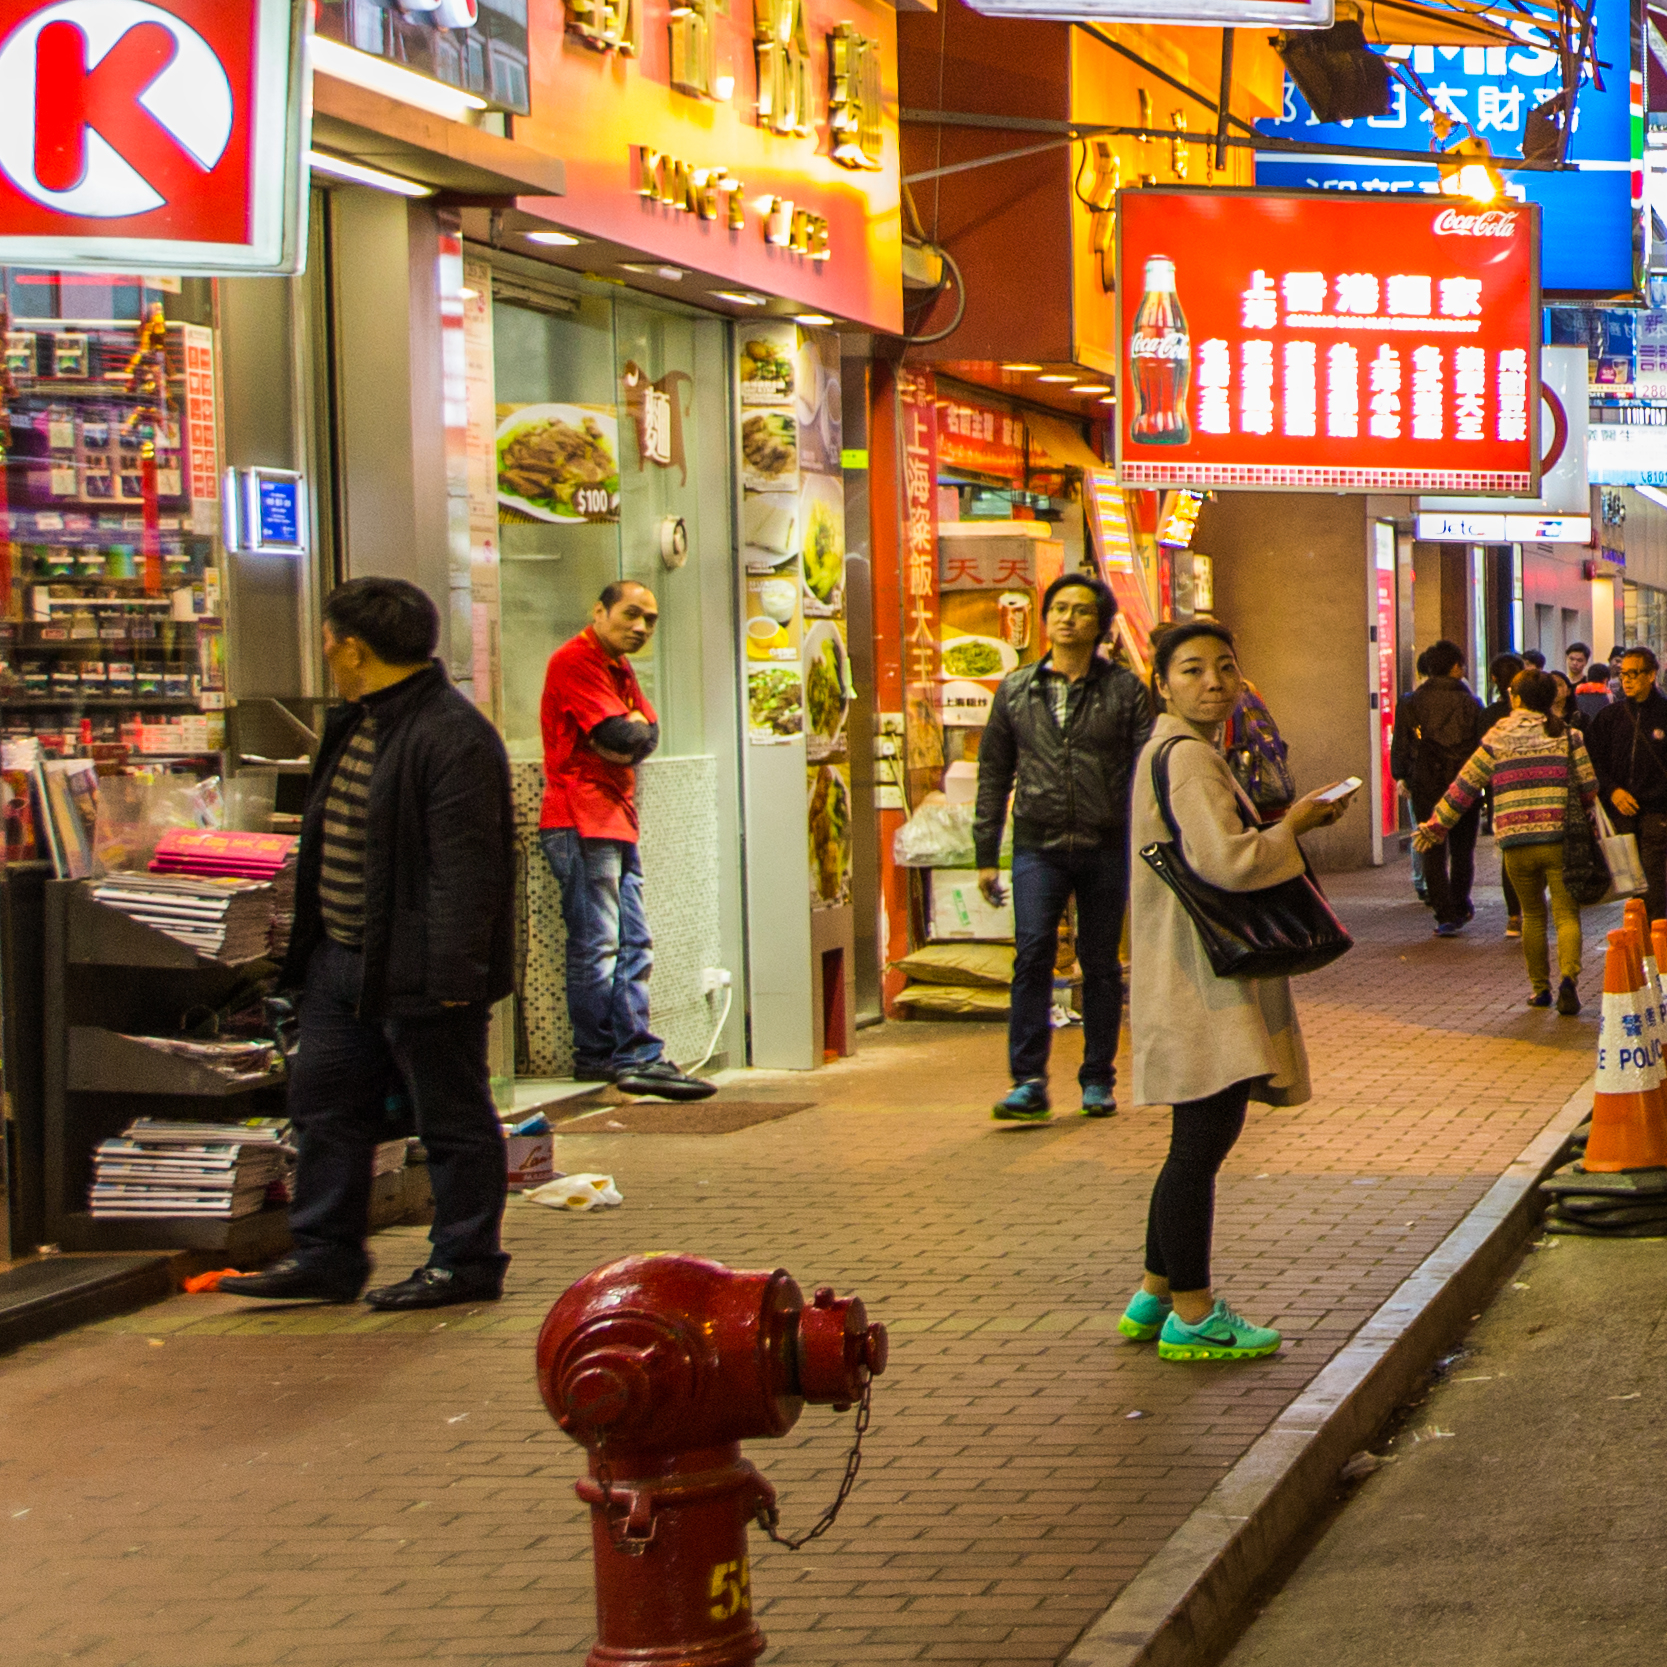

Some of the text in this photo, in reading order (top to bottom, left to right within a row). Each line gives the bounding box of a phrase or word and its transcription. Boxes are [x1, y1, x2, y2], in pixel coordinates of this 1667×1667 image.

[1434, 208, 1519, 238] Coca-Cola
[579, 488, 609, 515] $100
[944, 558, 1033, 586] 天天
